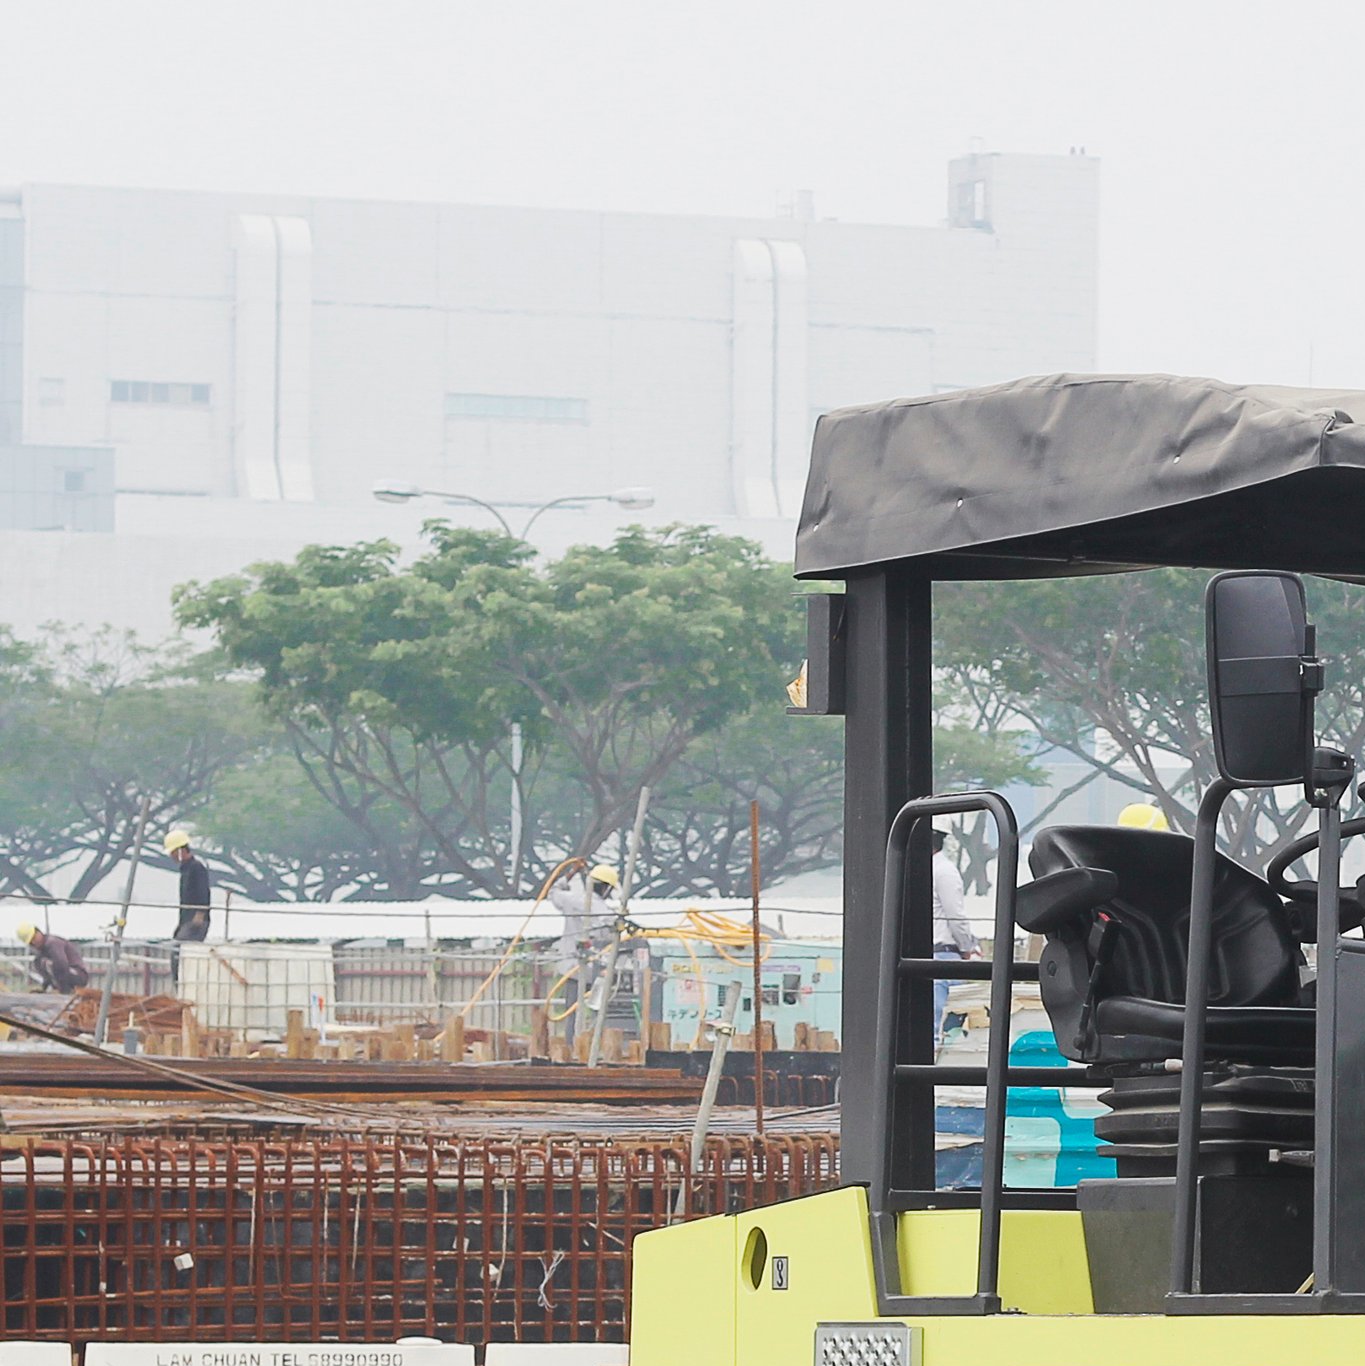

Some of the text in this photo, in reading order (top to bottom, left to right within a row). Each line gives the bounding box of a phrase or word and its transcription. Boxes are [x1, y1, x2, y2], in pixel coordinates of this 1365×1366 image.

[156, 1353, 193, 1366] LAM
[201, 1353, 261, 1366] CHUAN
[271, 1353, 304, 1366] TEL
